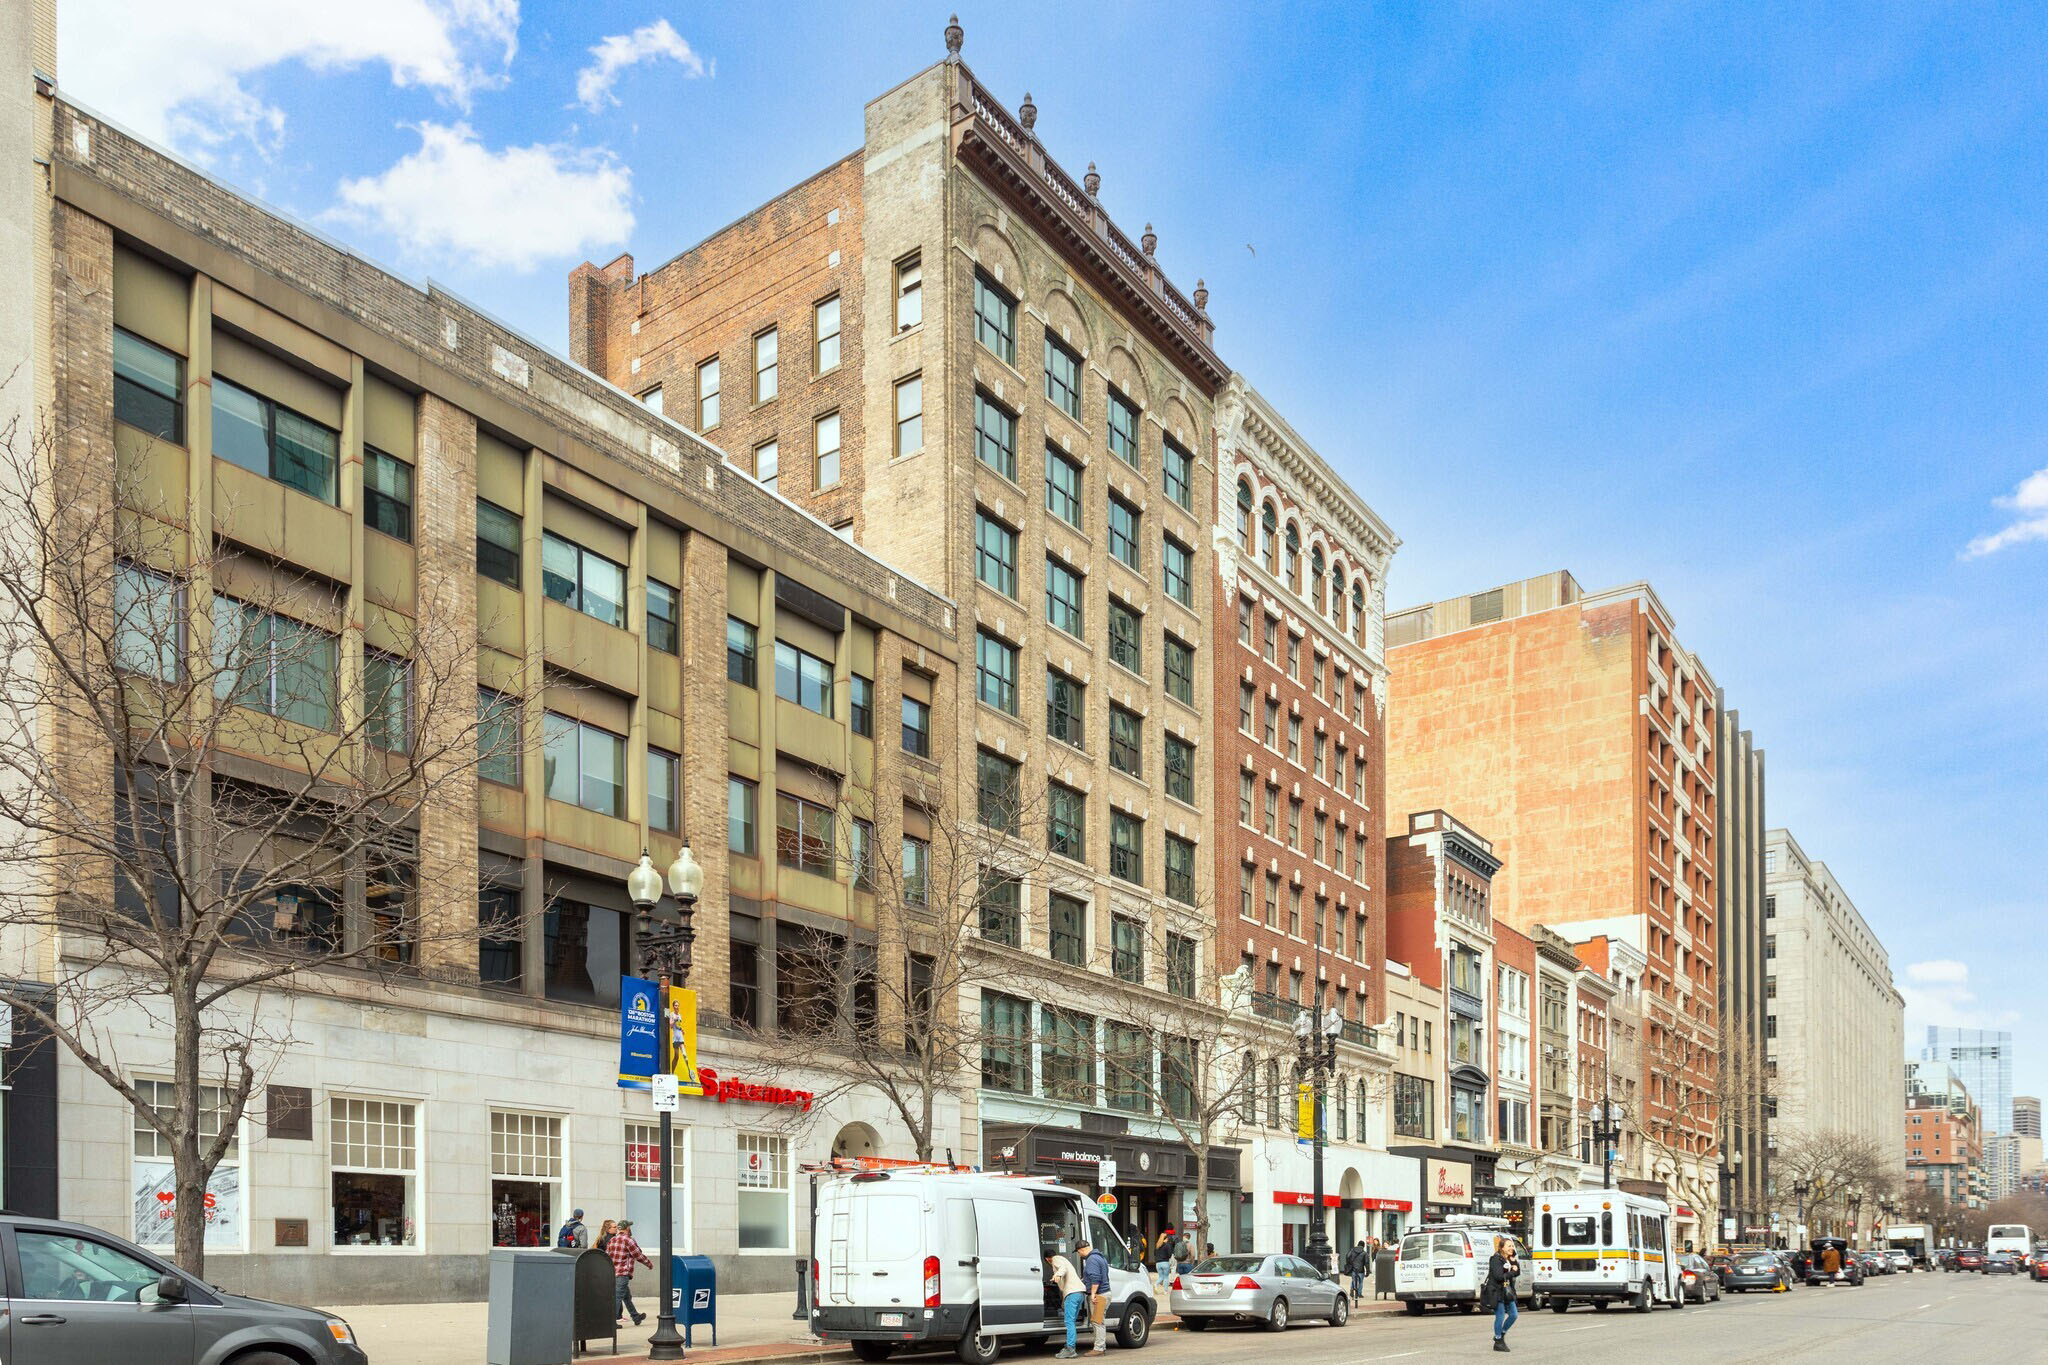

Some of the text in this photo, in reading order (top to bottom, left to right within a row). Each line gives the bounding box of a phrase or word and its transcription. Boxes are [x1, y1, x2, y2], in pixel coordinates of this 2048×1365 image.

[627, 1014, 656, 1023] MARATHON
[718, 1077, 814, 1112] pharmacy
[1061, 1151, 1101, 1163] new balance
